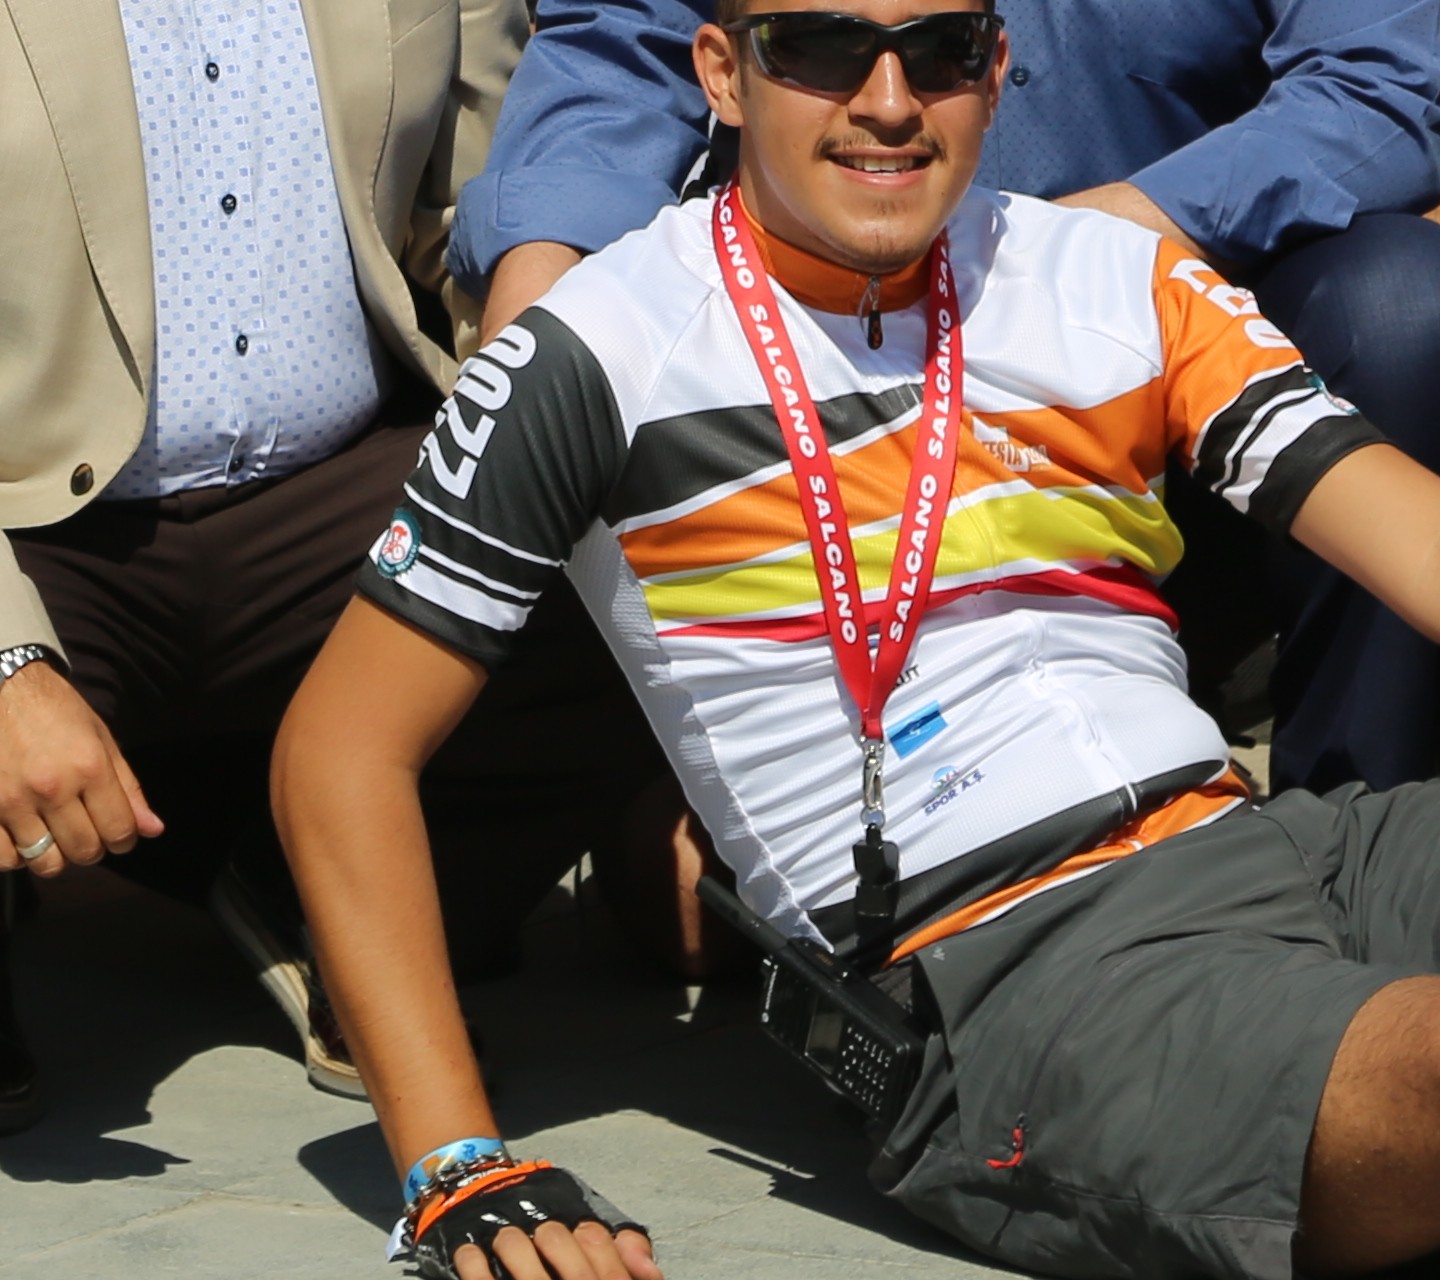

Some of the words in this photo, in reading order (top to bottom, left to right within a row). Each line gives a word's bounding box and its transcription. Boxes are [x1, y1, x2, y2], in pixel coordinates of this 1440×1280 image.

[718, 189, 755, 291] LCANO
[420, 324, 538, 500] 2200
[748, 303, 817, 459] SALCANO
[926, 307, 952, 460] SALCANO
[808, 473, 857, 645] SALCANO
[890, 473, 938, 643] SALCANO
[923, 789, 959, 817] SPOR
